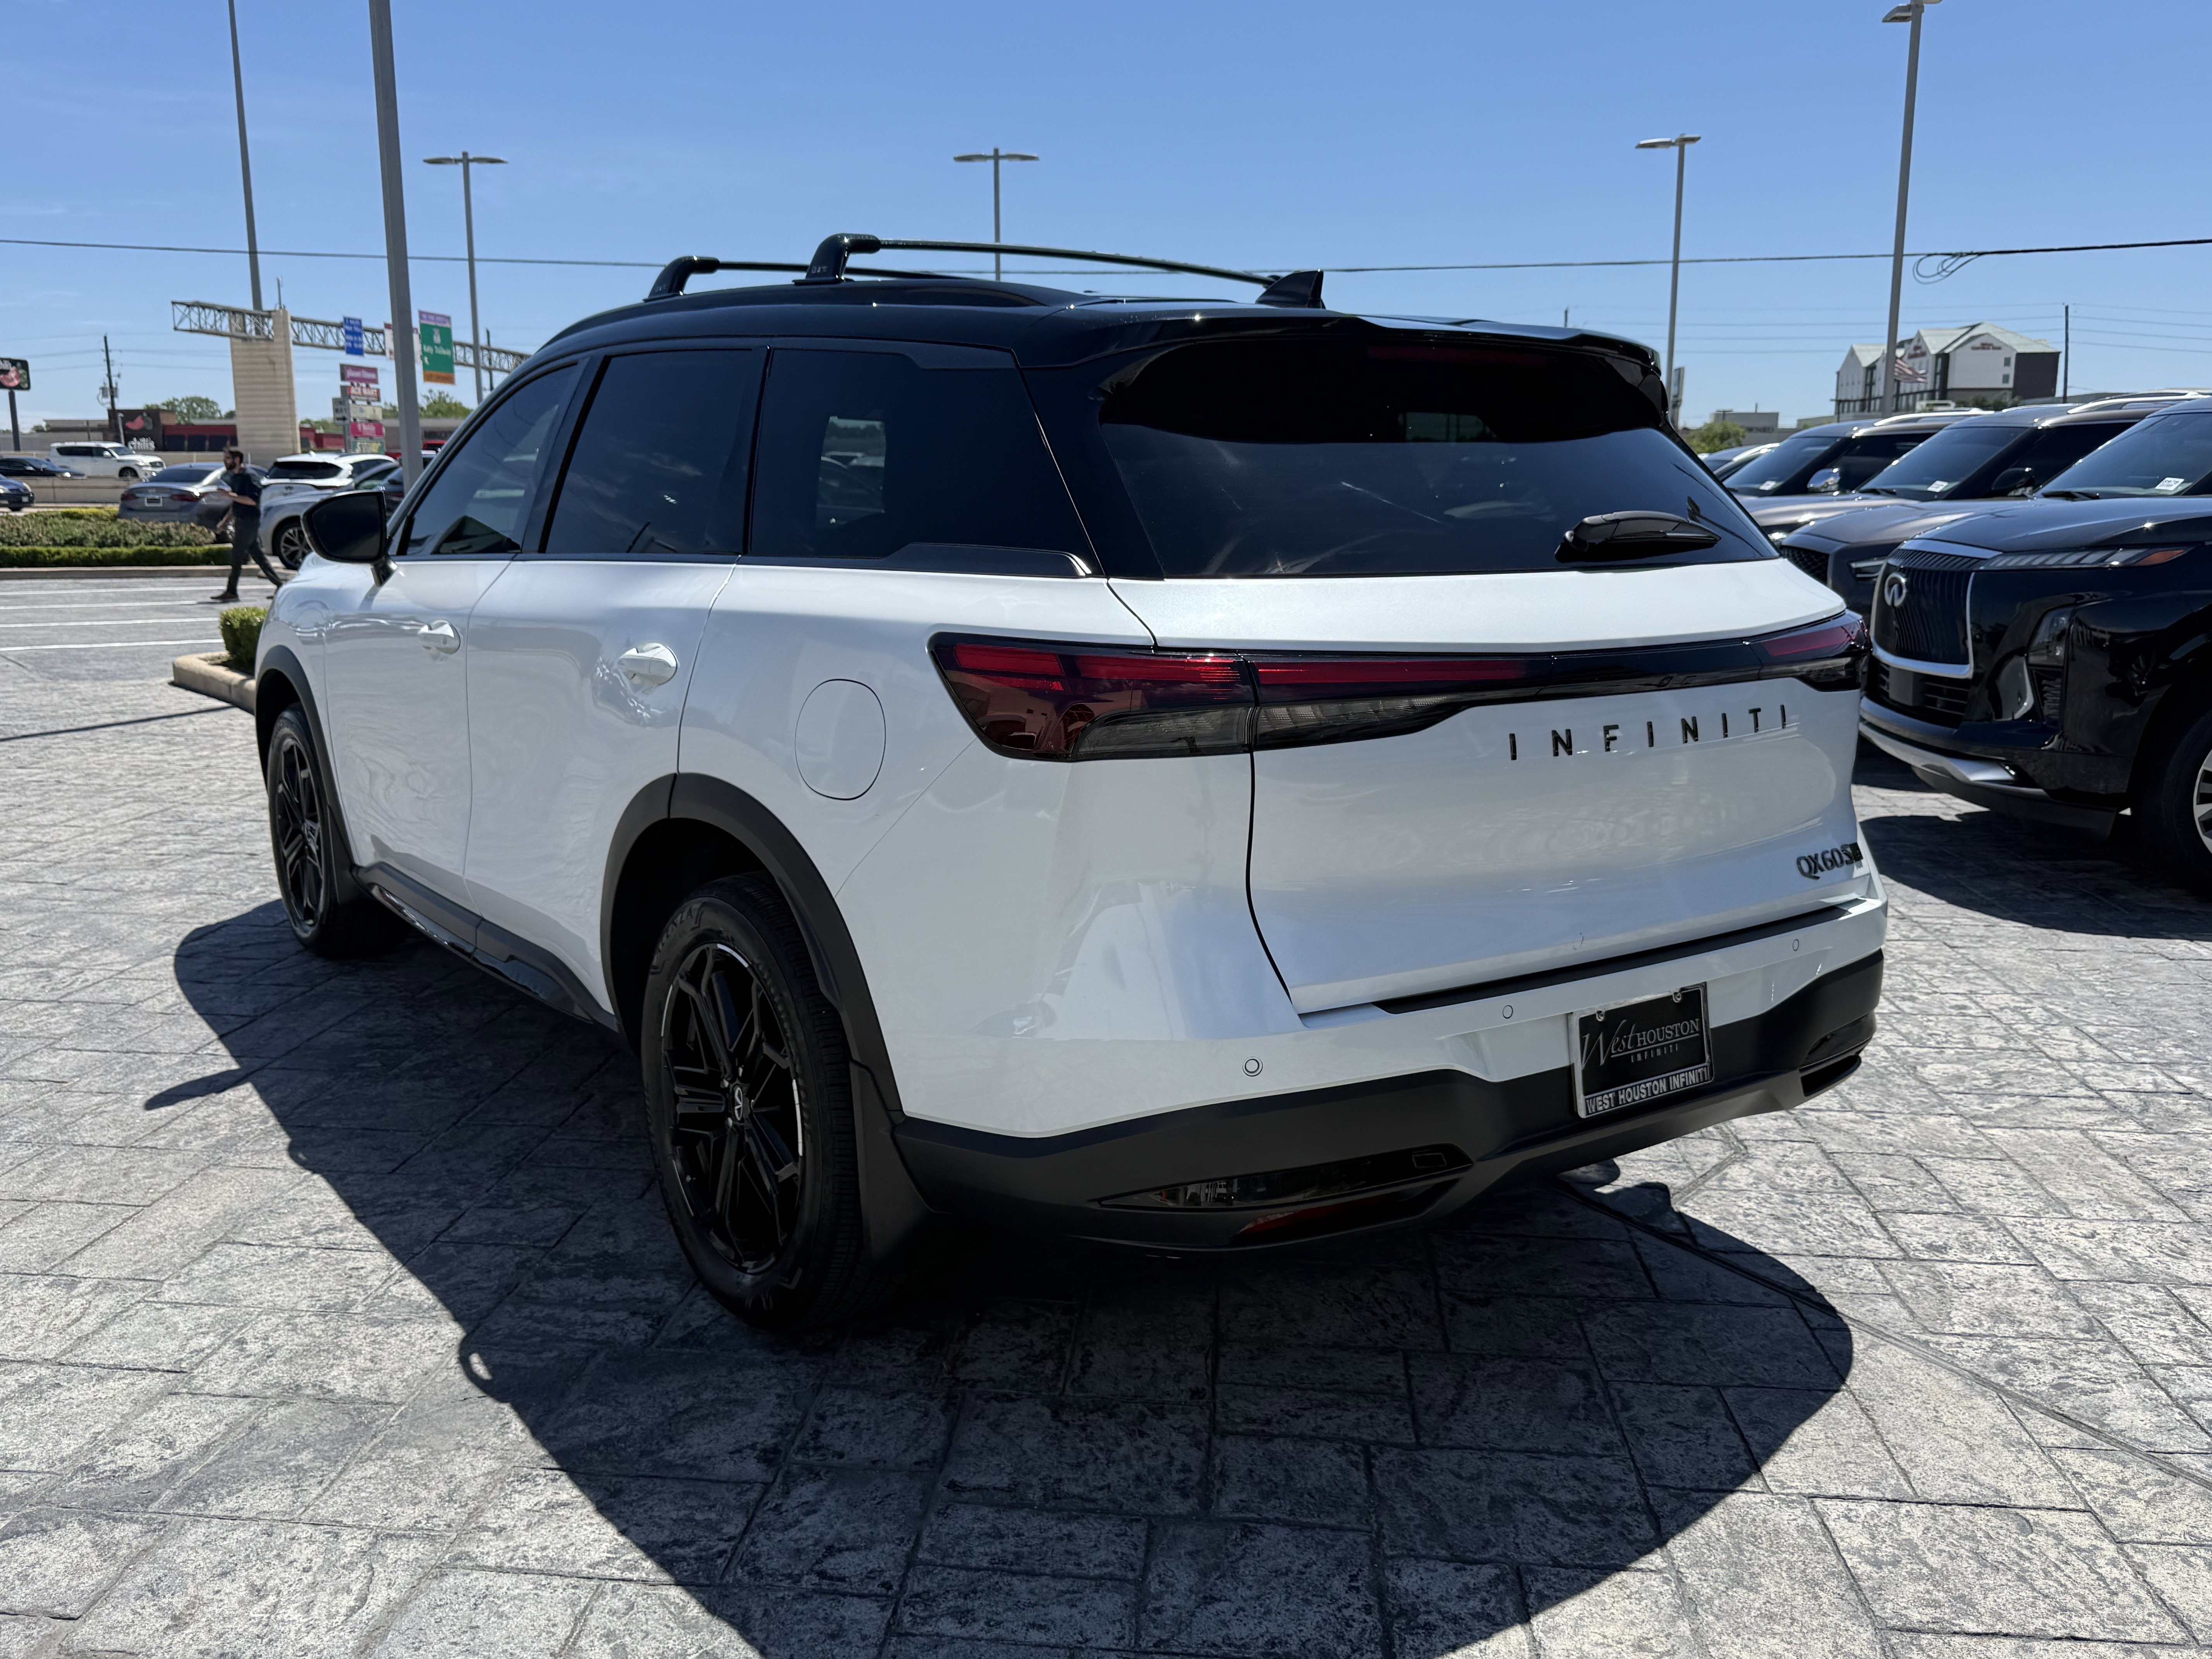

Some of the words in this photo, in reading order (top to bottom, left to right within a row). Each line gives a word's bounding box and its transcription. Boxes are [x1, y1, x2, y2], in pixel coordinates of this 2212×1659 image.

[128, 437, 155, 450] chili's
[1509, 704, 1786, 760] INFINITI
[1582, 1019, 1637, 1070] West
[1637, 1018, 1700, 1047] HOUSTON
[1631, 1043, 1678, 1063] INFINITI
[1586, 1093, 1615, 1113] WEST
[1618, 1078, 1667, 1105] HOUSTON
[1669, 1067, 1709, 1091] INFINITI
